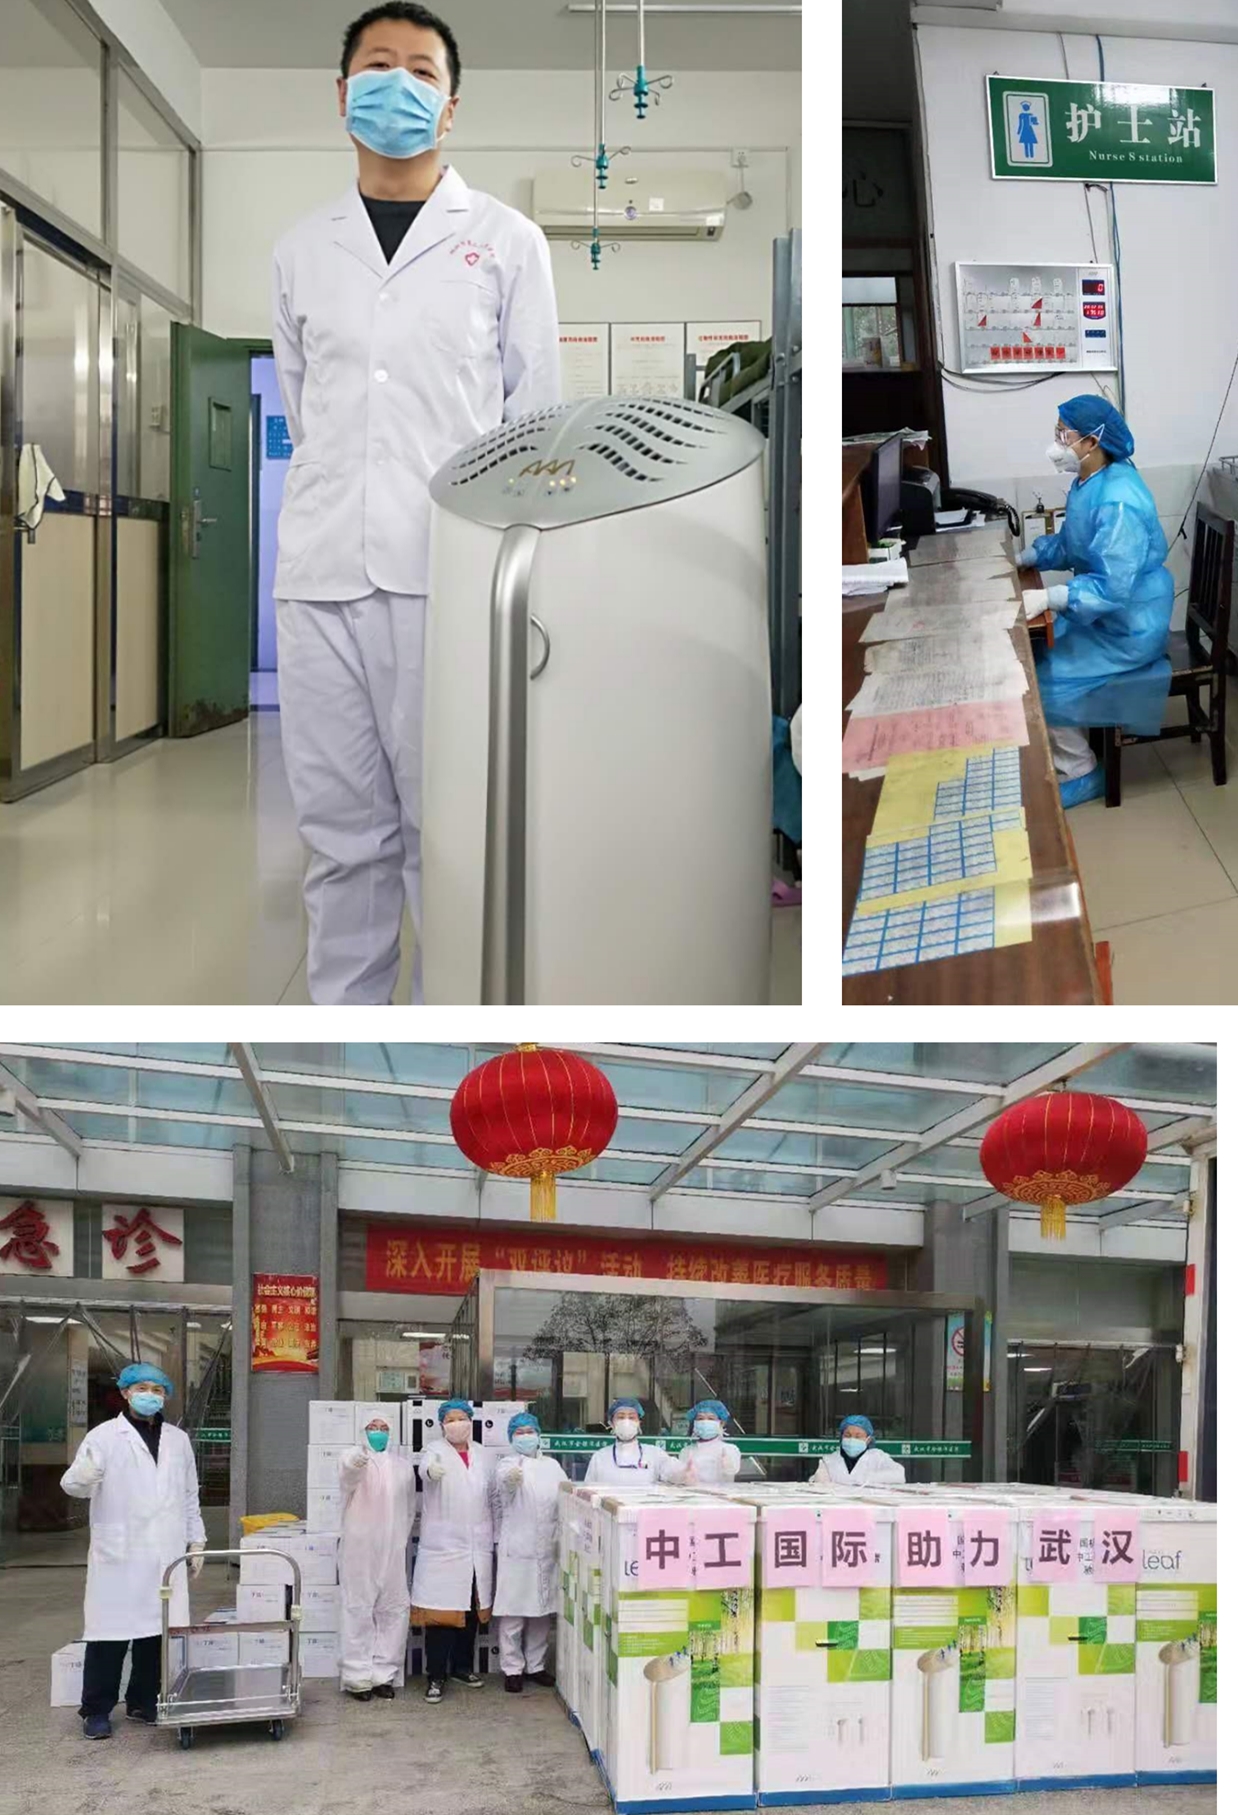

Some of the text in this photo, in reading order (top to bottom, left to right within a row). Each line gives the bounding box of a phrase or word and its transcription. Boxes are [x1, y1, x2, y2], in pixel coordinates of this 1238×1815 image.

[1064, 102, 1202, 149] 护士站
[1089, 150, 1125, 162] Nurse
[0, 1200, 183, 1275] 急诊
[1142, 1549, 1183, 1570] leaf
